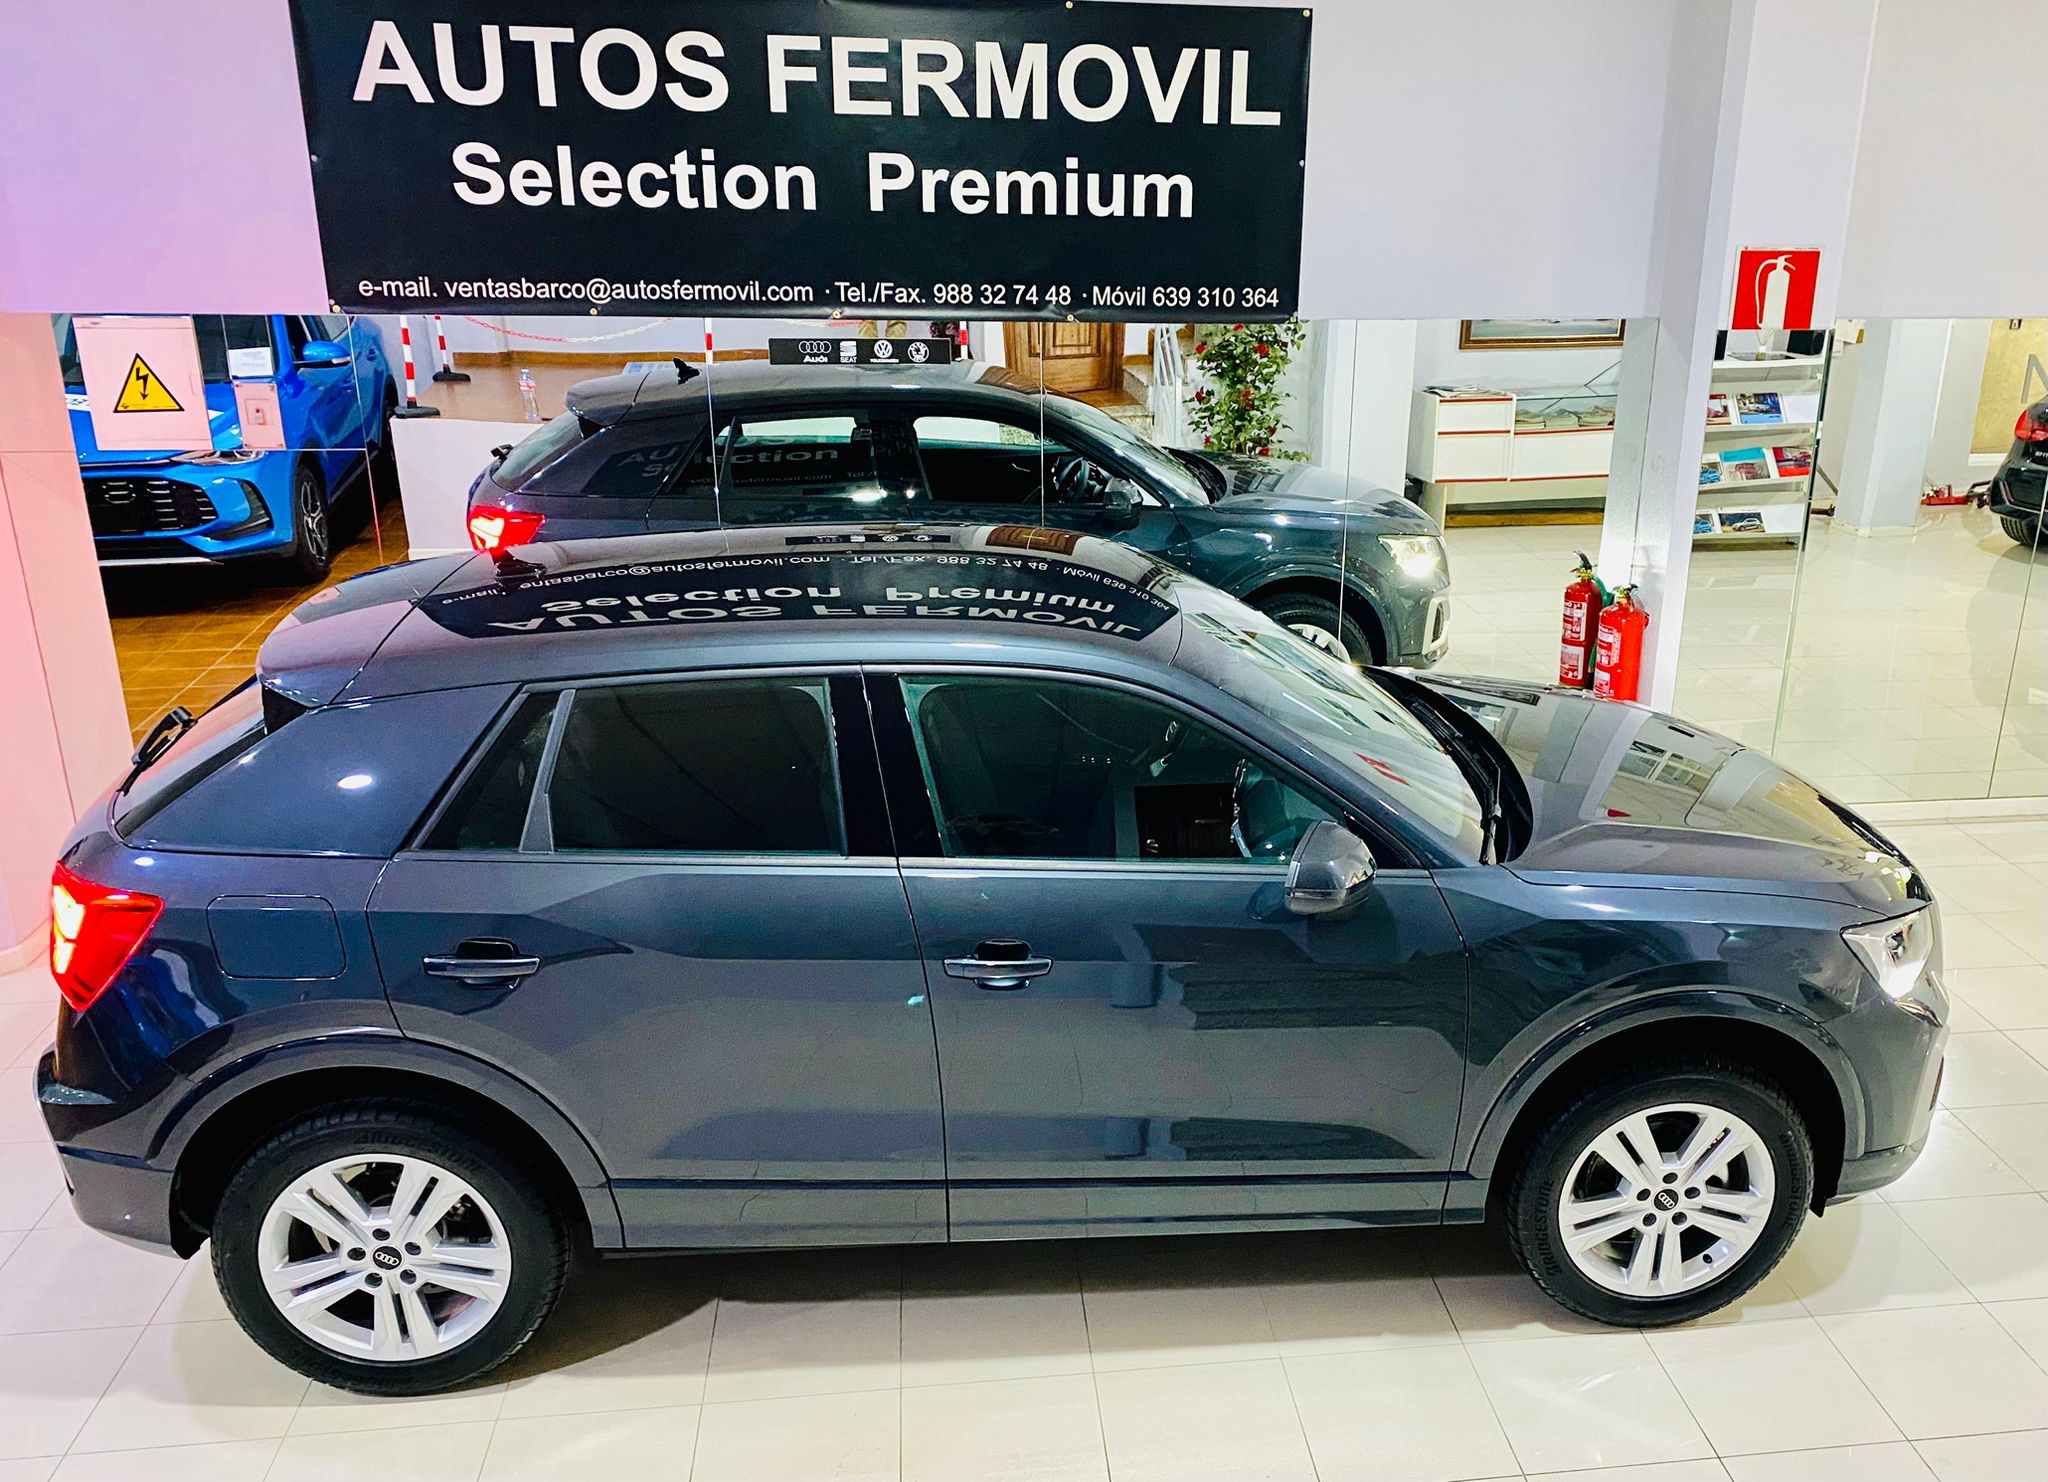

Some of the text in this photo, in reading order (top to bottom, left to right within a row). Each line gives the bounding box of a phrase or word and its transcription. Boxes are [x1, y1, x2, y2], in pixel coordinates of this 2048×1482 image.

[353, 21, 1281, 126] AUTOS FERMOVIL
[453, 142, 1193, 218] Selection Premium
[359, 277, 1279, 307] e-mail. ventasbarco@autosfermovil.com Tel./Fax. 988 32 74 48 Móvil 639 310 364
